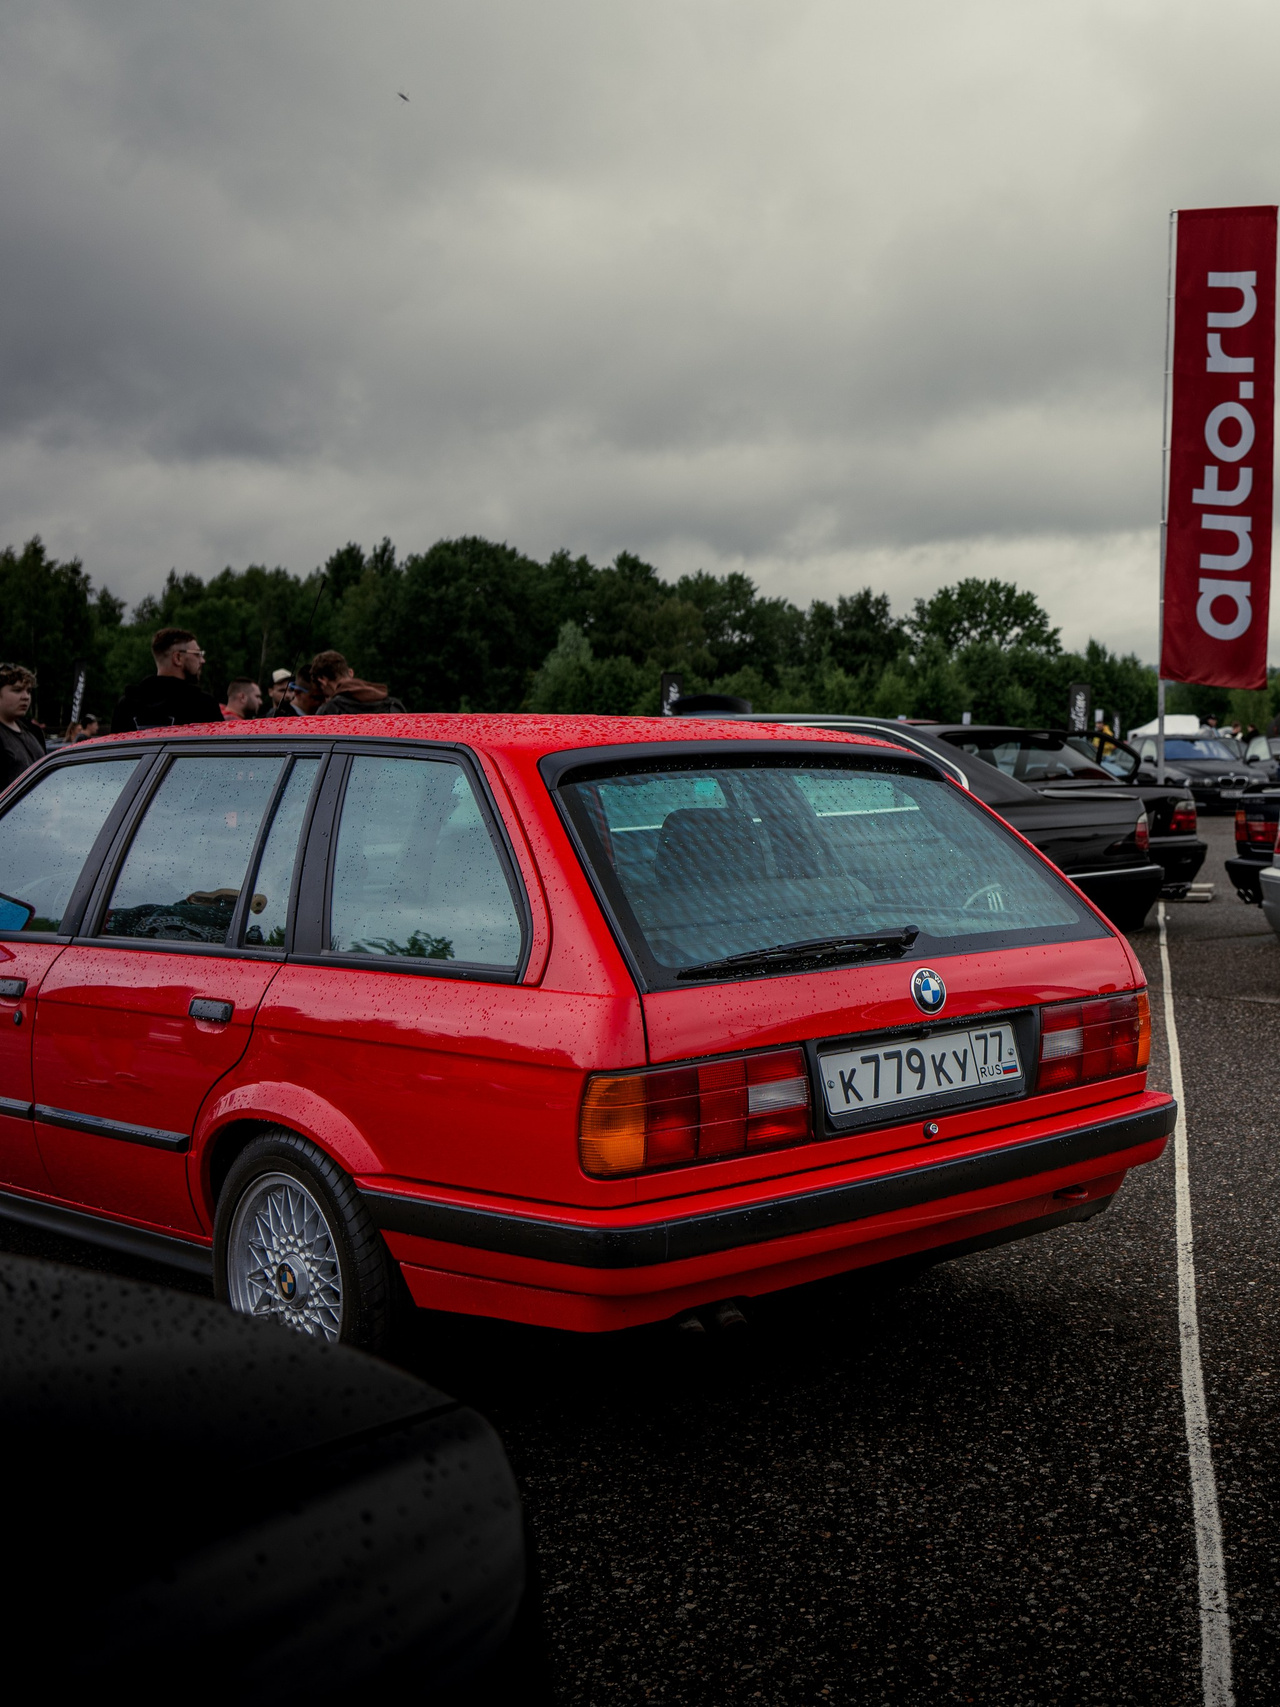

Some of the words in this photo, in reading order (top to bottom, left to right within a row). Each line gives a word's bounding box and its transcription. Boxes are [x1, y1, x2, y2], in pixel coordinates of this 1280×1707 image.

[1192, 270, 1258, 641] auto.ru
[915, 971, 941, 985] BMW
[974, 1030, 1003, 1066] 77
[980, 1063, 1003, 1078] RUS
